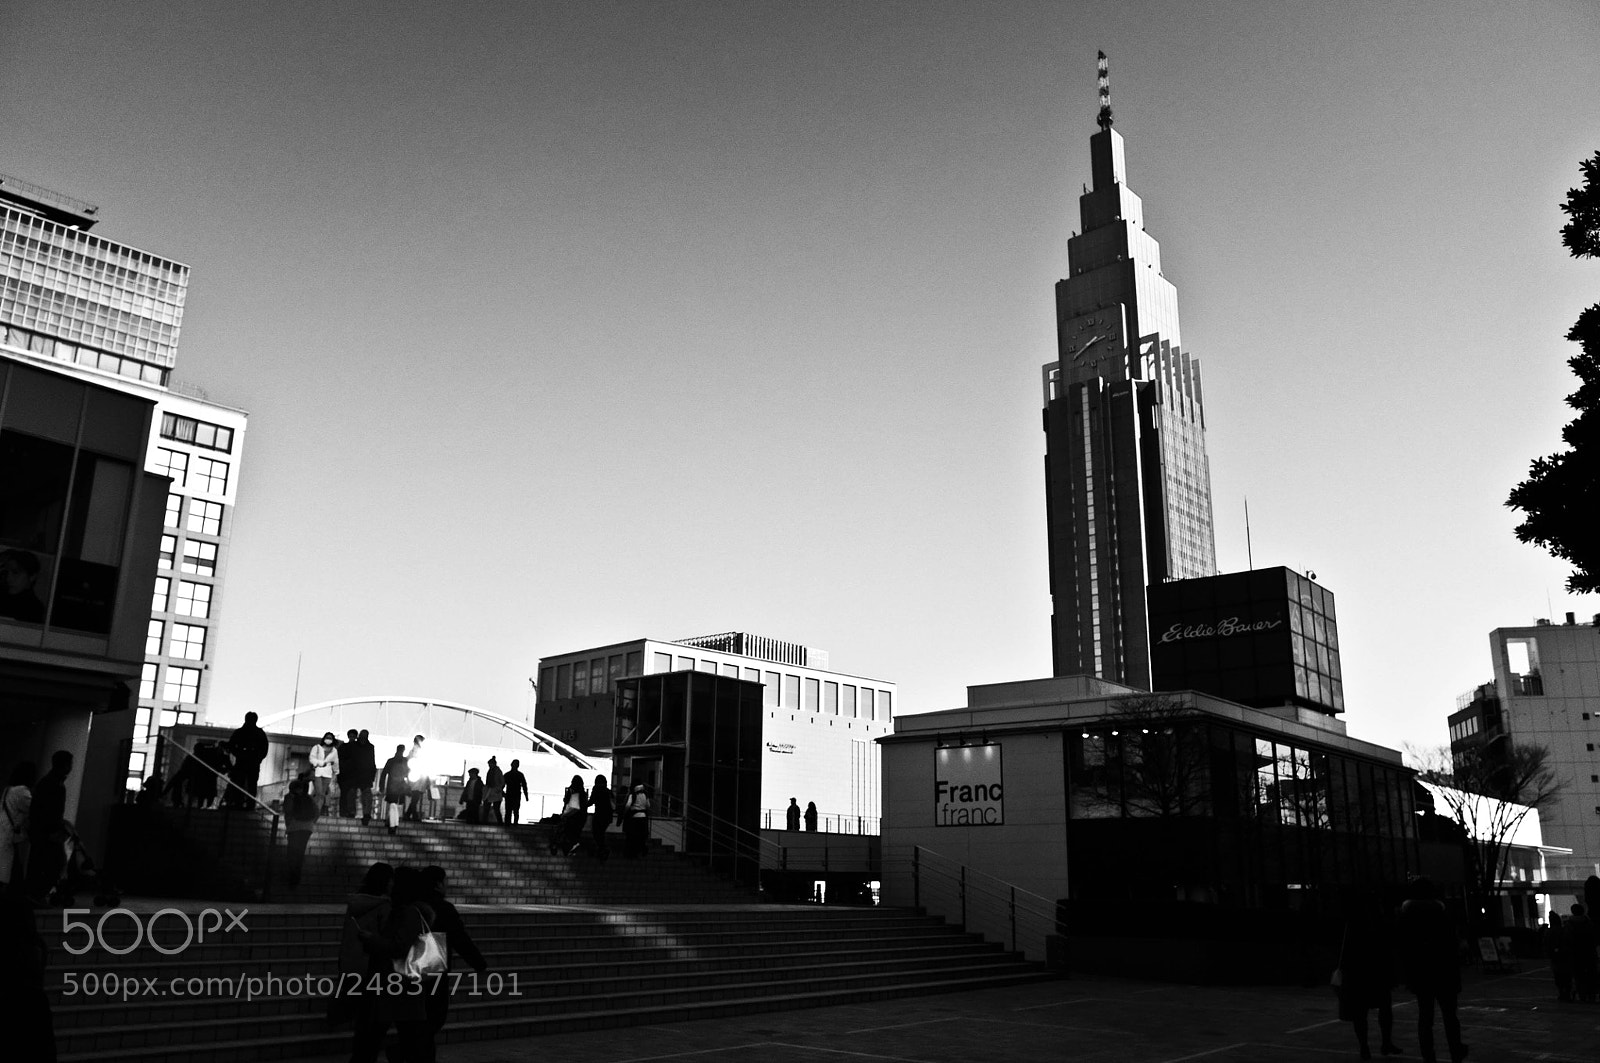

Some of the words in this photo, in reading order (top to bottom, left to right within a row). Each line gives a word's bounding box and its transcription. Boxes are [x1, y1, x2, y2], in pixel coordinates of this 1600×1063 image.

[1157, 623, 1216, 645] Eddie
[1217, 617, 1281, 636] Bauer
[936, 781, 1002, 803] Franc
[942, 803, 997, 825] franc
